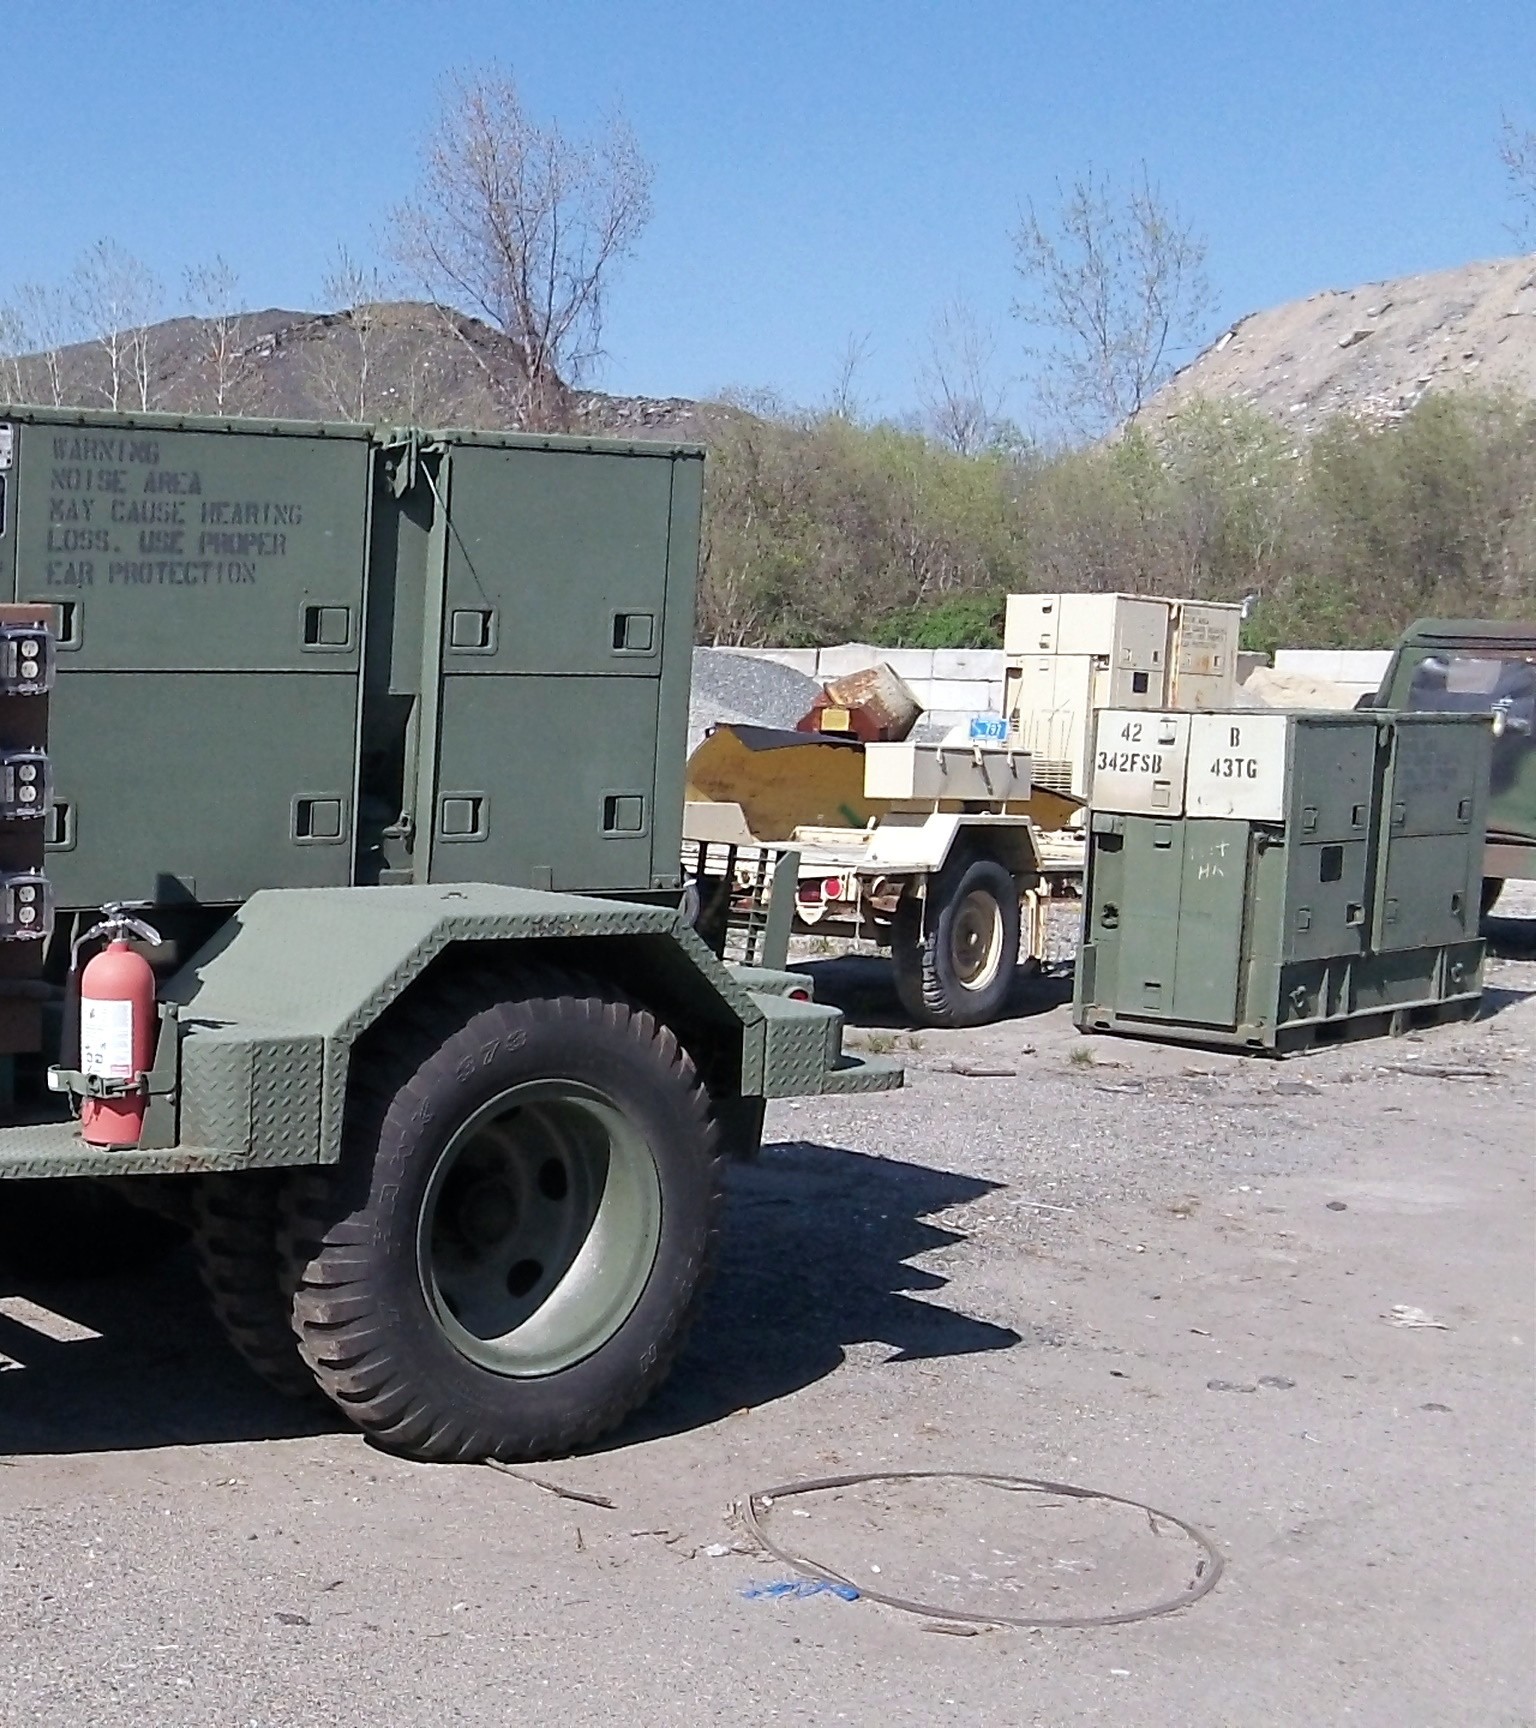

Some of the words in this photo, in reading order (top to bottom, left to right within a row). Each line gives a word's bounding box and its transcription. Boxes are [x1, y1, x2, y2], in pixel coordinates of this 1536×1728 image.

[52, 437, 161, 465] WARNING
[51, 467, 128, 494] NOISE
[143, 471, 202, 496] AREA
[49, 498, 95, 522] MAY
[111, 500, 186, 525] CAUSE
[200, 501, 303, 526] HEARING
[138, 529, 185, 556] USE
[199, 531, 286, 556] PROPER
[46, 560, 94, 586] EAR
[108, 561, 257, 586] PROTECTION
[1121, 722, 1143, 743] 42
[1229, 726, 1241, 748] B
[1097, 751, 1163, 774] 342FSB
[1210, 757, 1258, 779] 43TG
